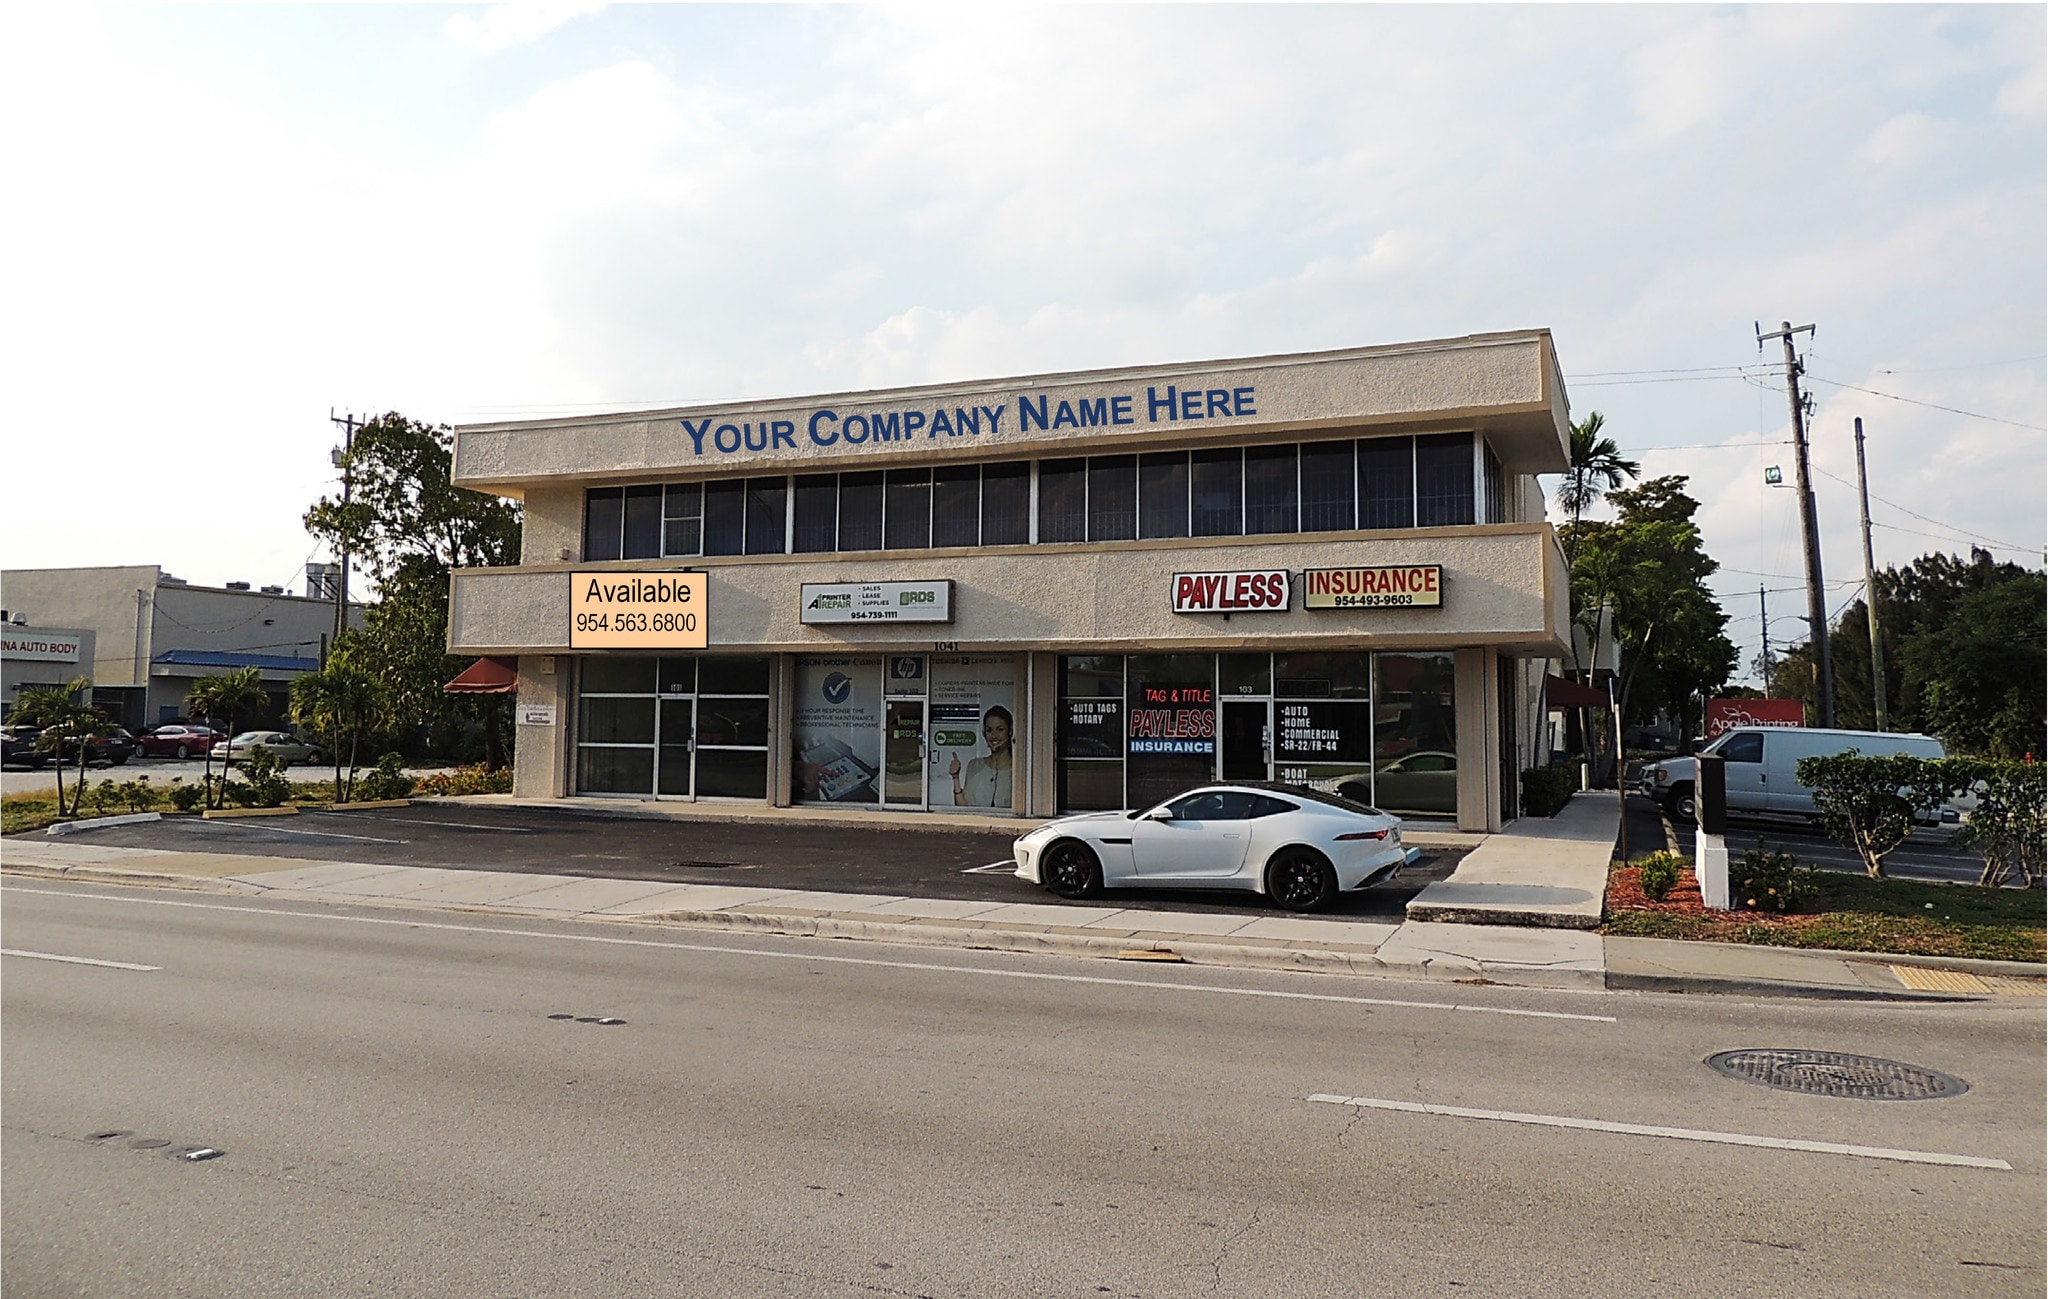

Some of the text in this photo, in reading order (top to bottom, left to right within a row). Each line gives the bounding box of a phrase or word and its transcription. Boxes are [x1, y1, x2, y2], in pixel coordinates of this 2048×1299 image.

[1309, 568, 1437, 595] INSURANCE
[821, 593, 852, 601] PRINTER
[910, 591, 935, 603] RDS
[1176, 574, 1284, 609] PAYLESS
[822, 600, 852, 609] REPAIR
[1335, 594, 1413, 606] 954-493-9603
[851, 611, 898, 619] 954-739-1111
[20, 641, 48, 653] AUTO
[50, 643, 78, 654] BODY
[934, 641, 960, 652] 1041
[900, 657, 916, 678] hp
[1145, 689, 1212, 703] TAG & TITLE
[1073, 703, 1117, 713] AUTO TAGS
[1285, 706, 1308, 716] AUTO
[1073, 714, 1103, 724] NOTARY
[1130, 709, 1216, 737] PAYLESS
[1284, 717, 1311, 727] HOME
[1710, 717, 1799, 731] Apple Printing
[1284, 729, 1340, 740] COMMERCIAL
[1131, 741, 1213, 752] INSURANCE
[1284, 740, 1337, 751] SR-22/FR-44
[1284, 768, 1308, 779] BOAT
